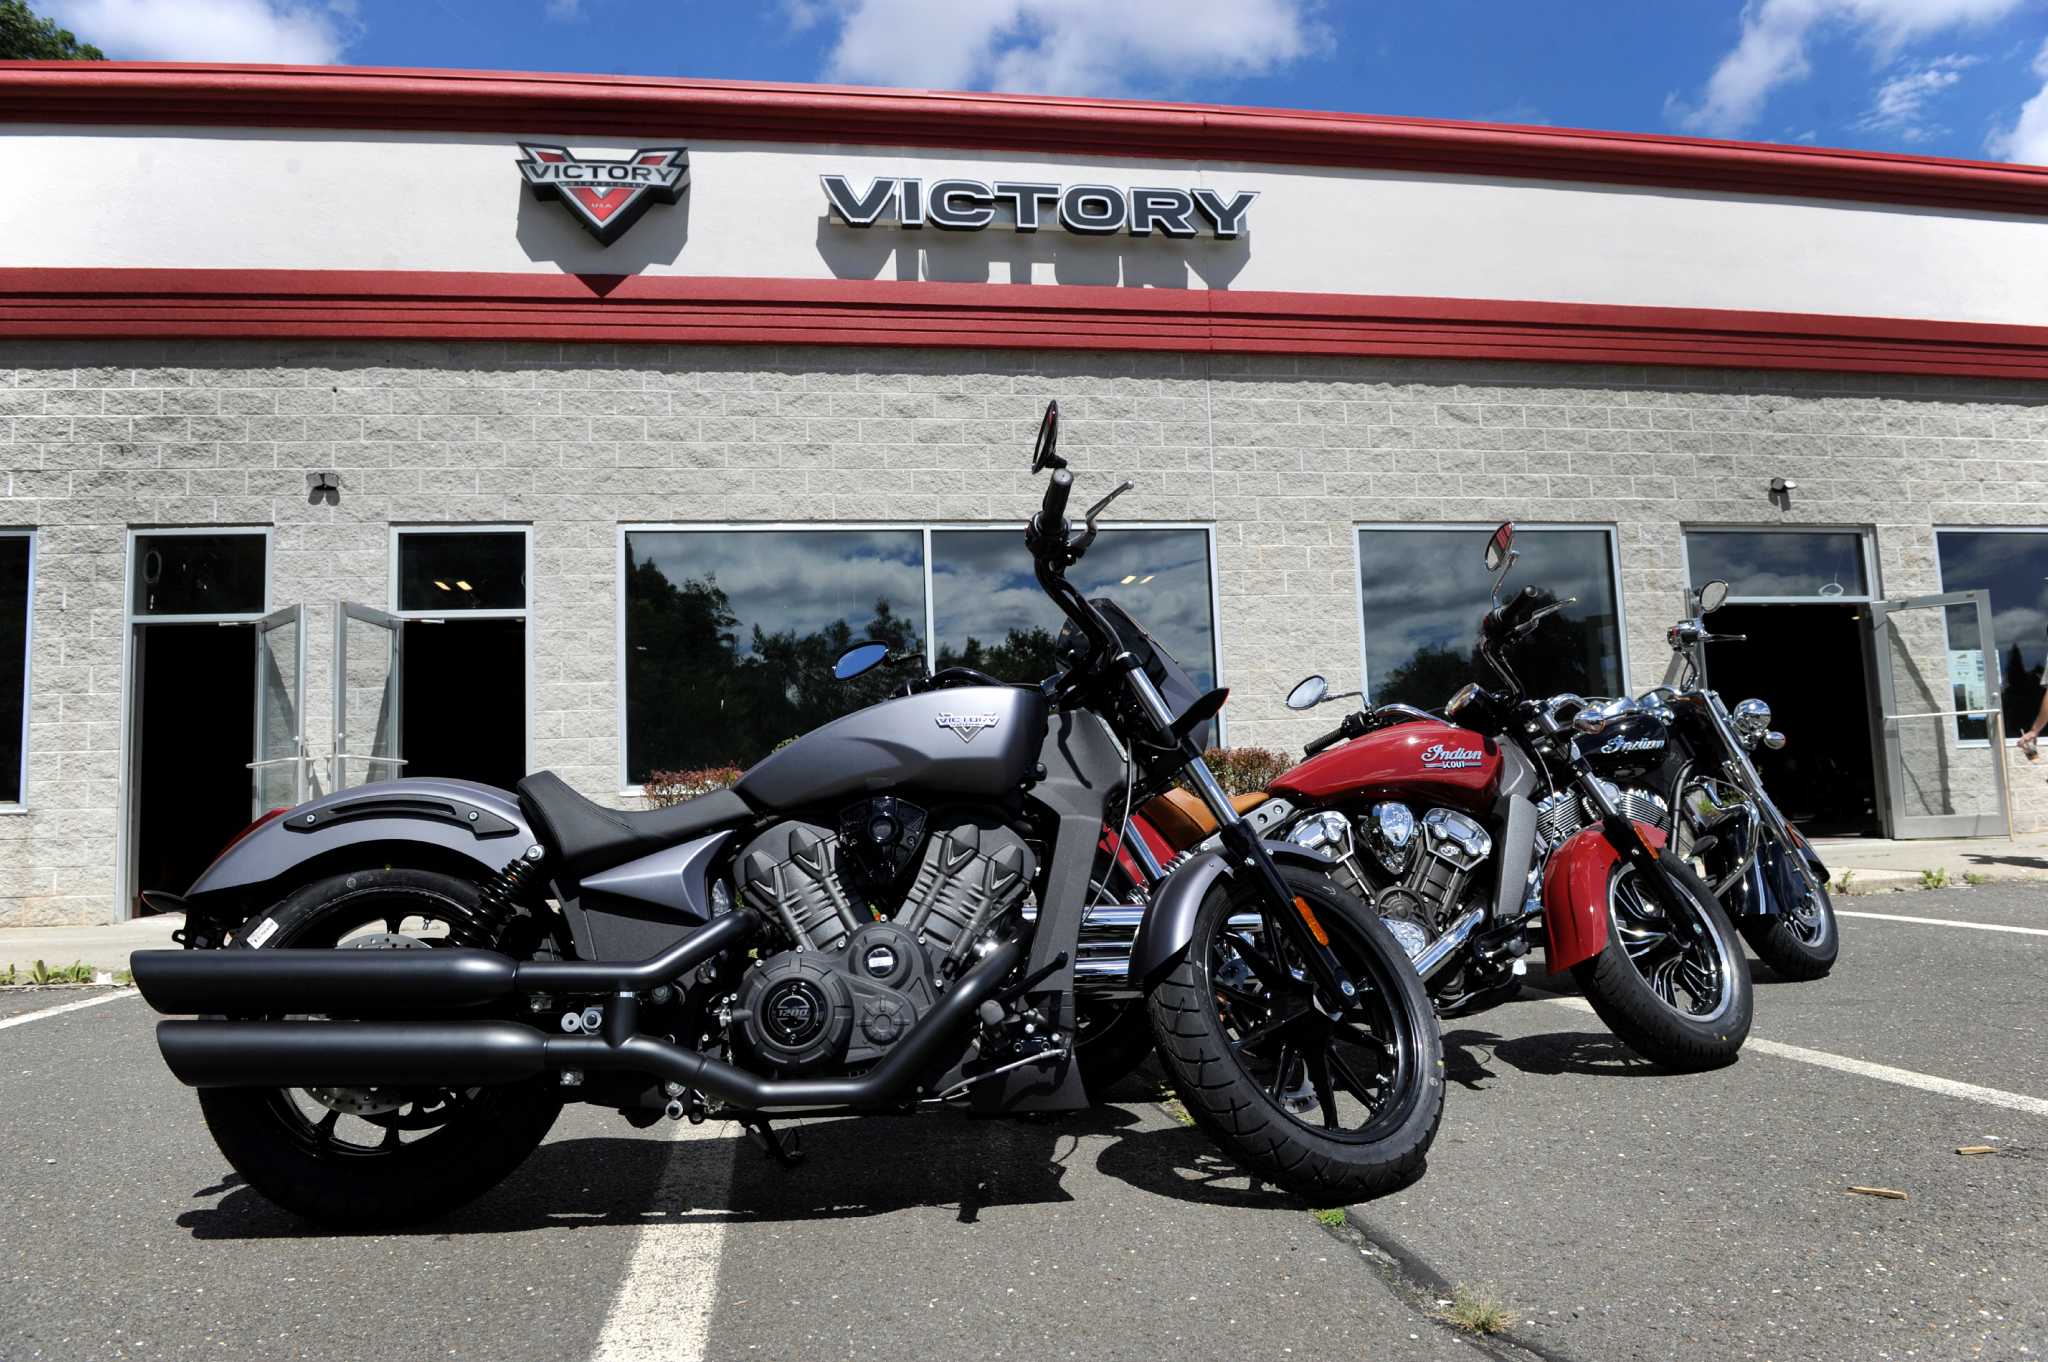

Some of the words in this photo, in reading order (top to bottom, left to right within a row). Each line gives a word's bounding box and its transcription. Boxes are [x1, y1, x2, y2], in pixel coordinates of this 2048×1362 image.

[528, 164, 675, 183] VICTORY
[819, 175, 1260, 238] VICTORY
[1421, 744, 1482, 761] Indian
[1600, 734, 1665, 754] Indian
[1442, 761, 1465, 769] SCOUT
